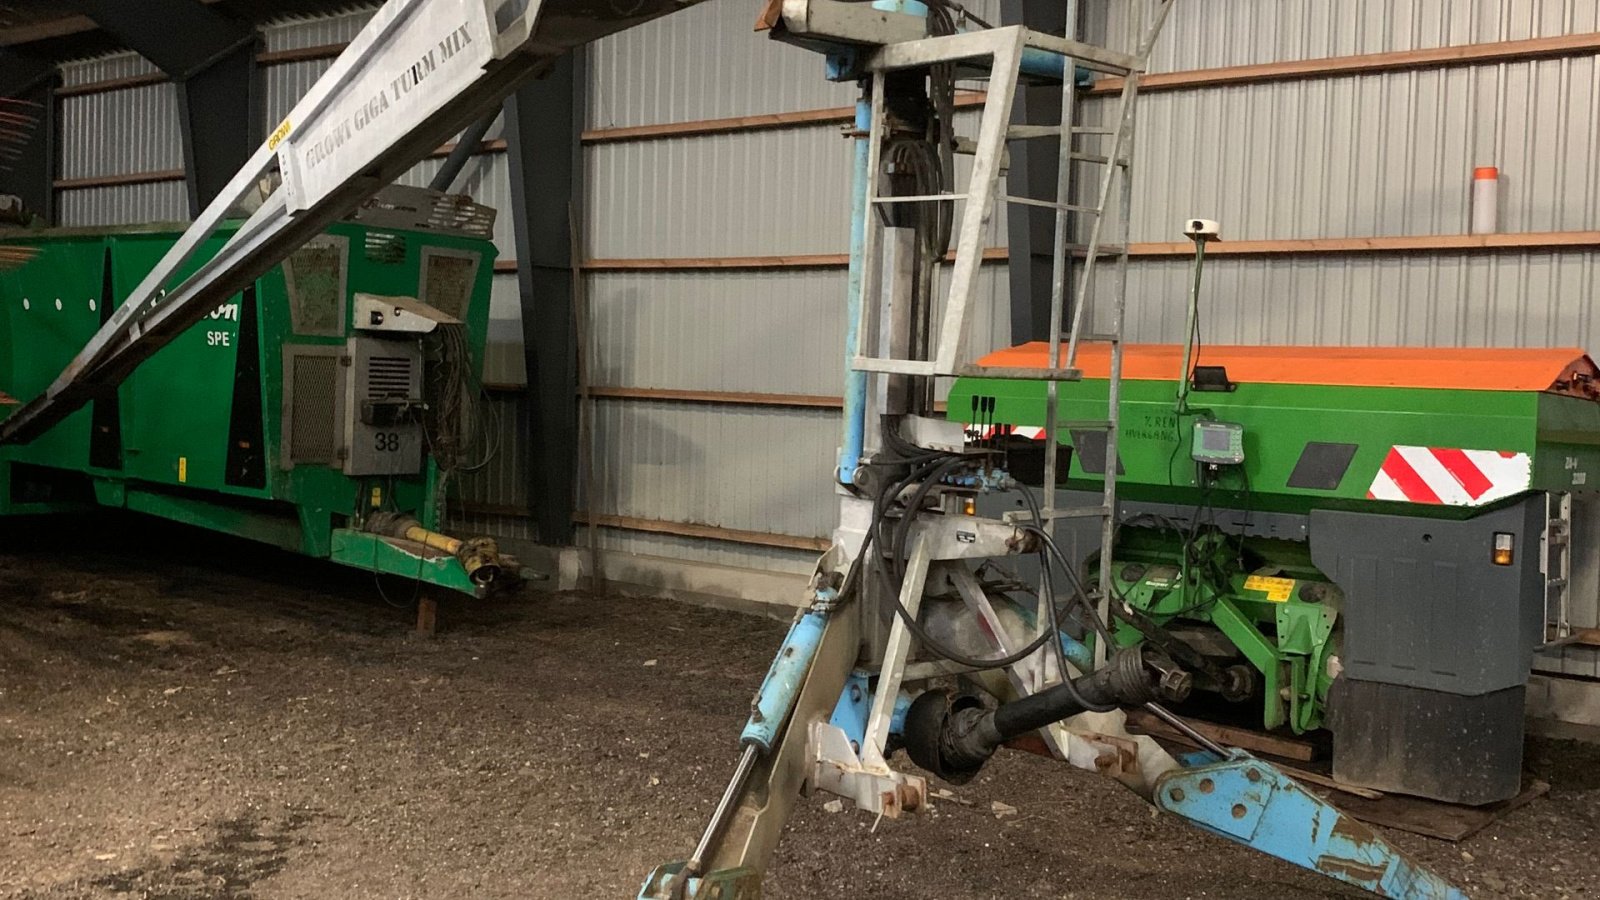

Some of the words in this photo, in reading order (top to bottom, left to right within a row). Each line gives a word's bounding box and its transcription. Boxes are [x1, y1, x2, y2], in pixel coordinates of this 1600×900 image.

[354, 90, 390, 131] GIGA
[390, 50, 436, 102] TURM
[439, 21, 473, 63] MIX
[207, 331, 230, 347] SPE
[374, 432, 400, 452] 38
